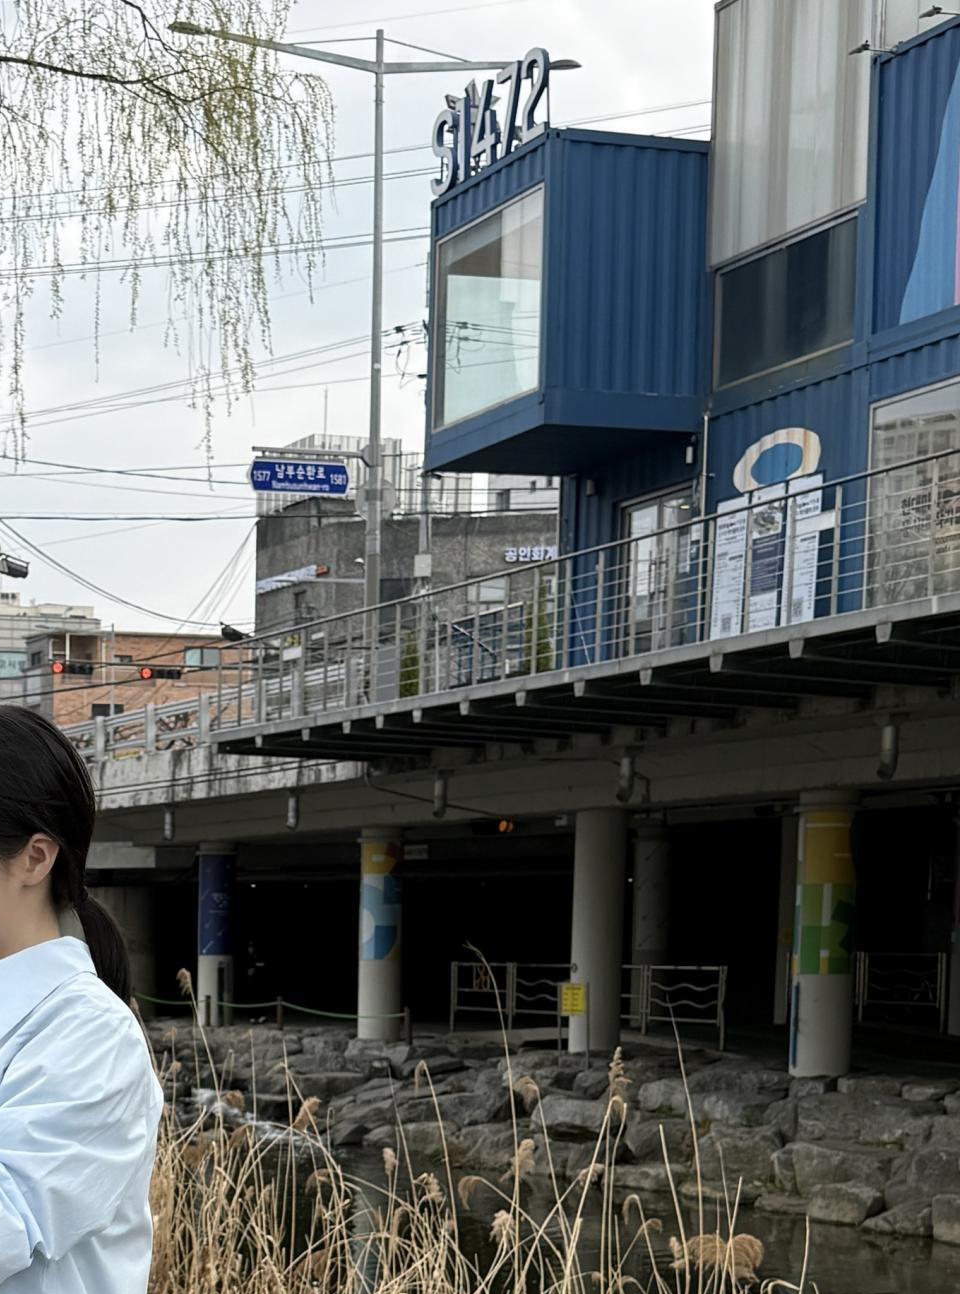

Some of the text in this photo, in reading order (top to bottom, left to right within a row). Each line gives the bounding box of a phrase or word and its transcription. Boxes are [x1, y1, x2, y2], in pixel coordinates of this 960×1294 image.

[430, 47, 550, 196] S1472
[253, 470, 271, 482] 1577
[275, 463, 327, 480] 남부순환로
